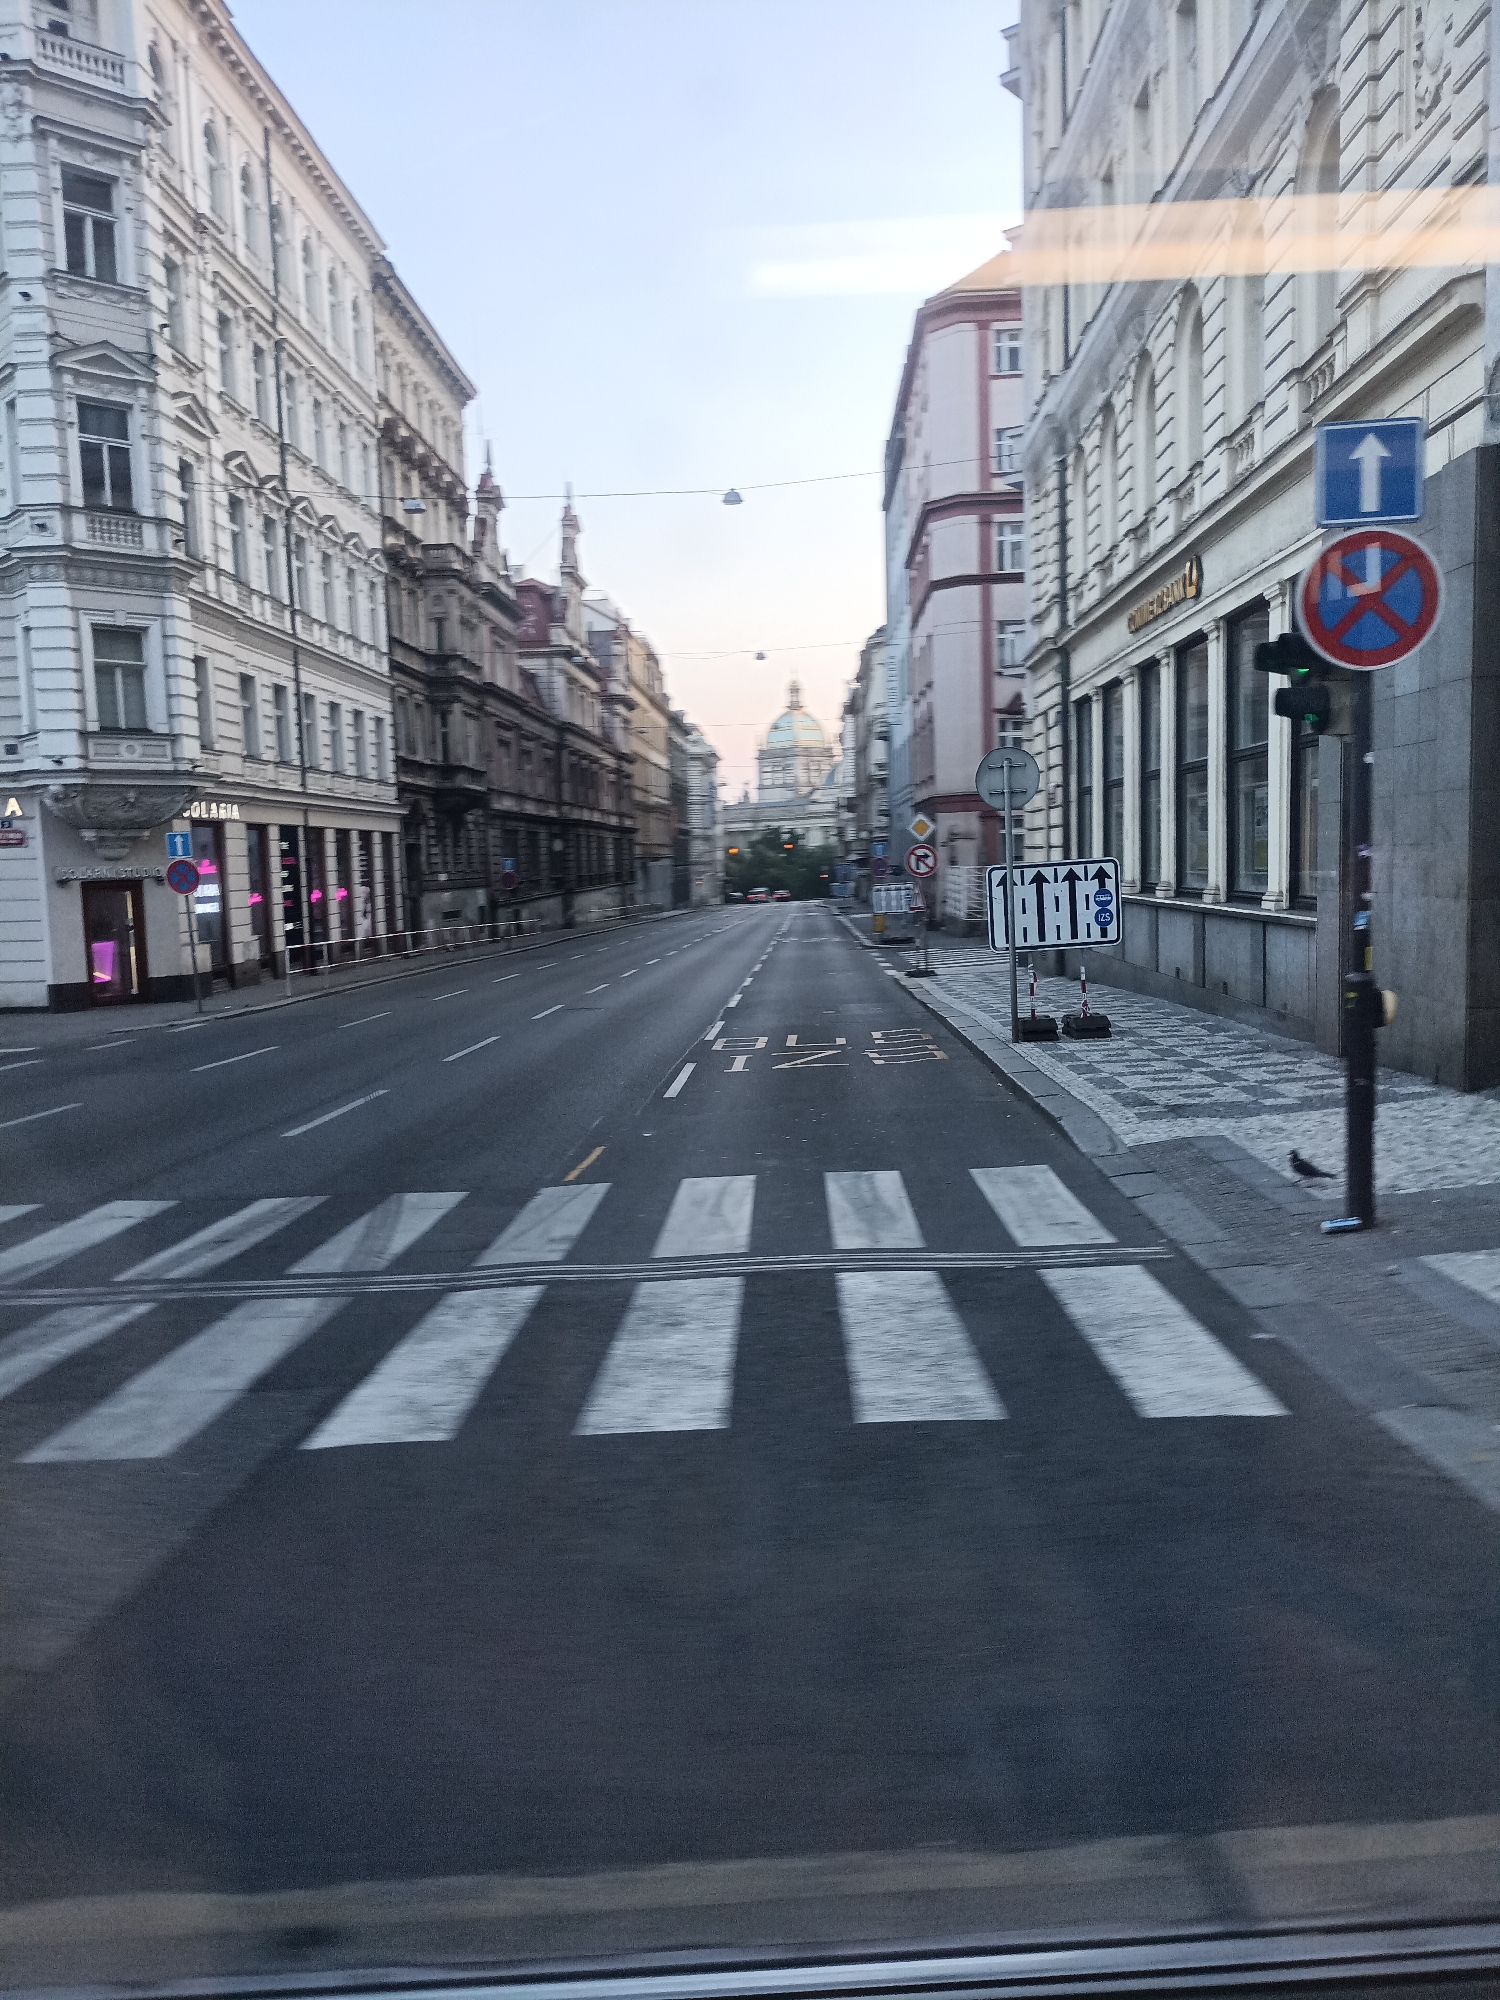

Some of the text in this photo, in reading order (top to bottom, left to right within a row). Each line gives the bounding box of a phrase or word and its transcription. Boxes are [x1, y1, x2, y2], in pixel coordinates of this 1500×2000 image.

[1098, 912, 1111, 922] IZS
[711, 1028, 933, 1051] BUS
[724, 1044, 950, 1073] IZS
